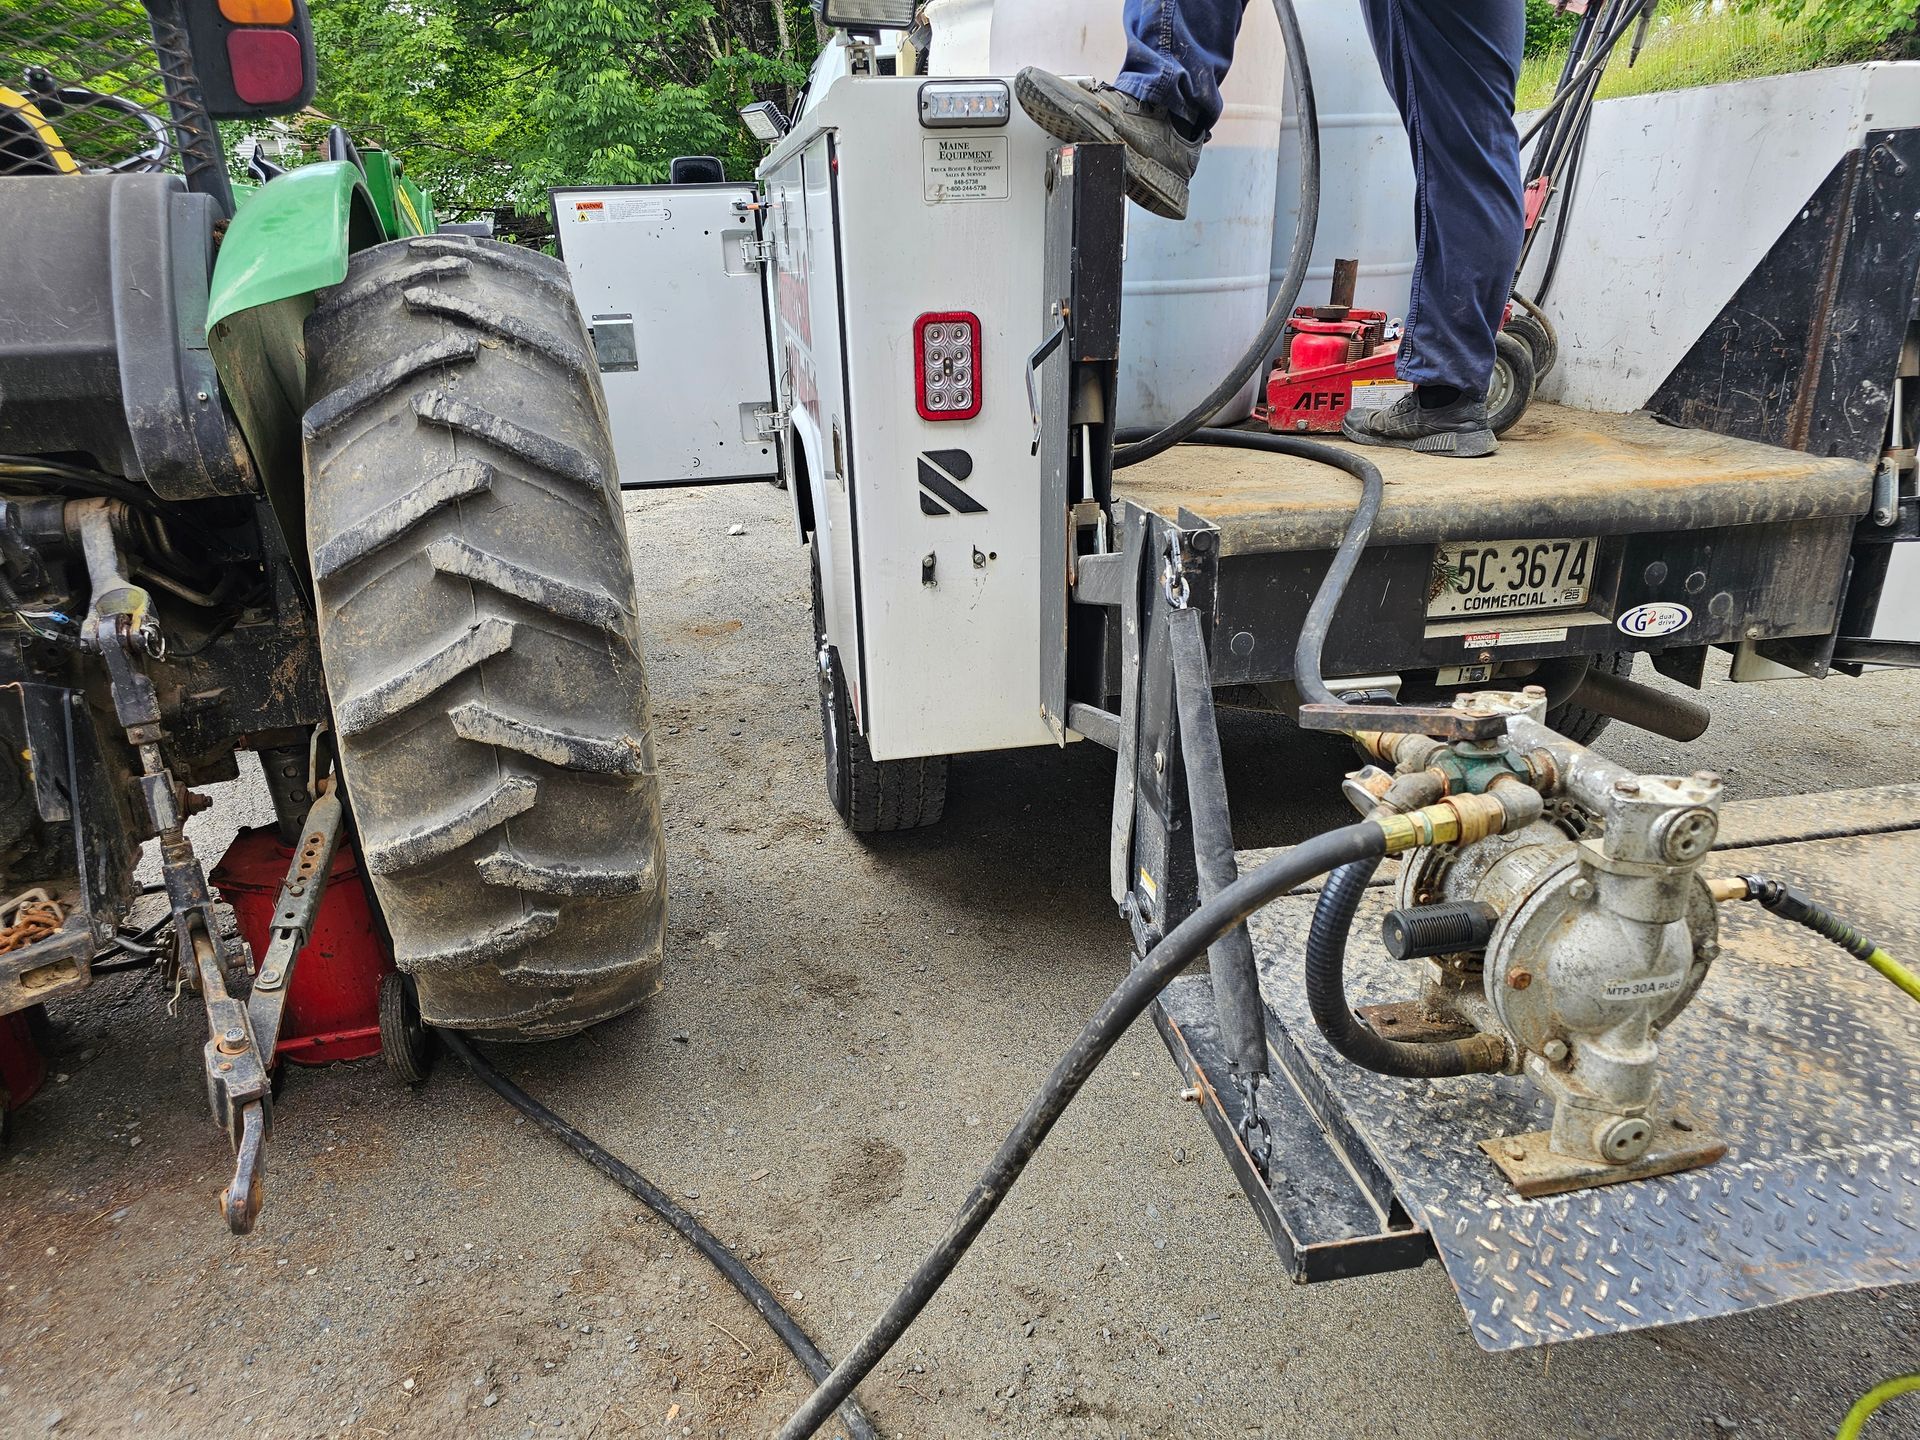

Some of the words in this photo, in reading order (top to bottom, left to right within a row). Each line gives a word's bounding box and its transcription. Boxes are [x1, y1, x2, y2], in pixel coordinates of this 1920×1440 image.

[939, 142, 970, 150] MAINE
[939, 150, 992, 161] EQUIPMENT
[1293, 392, 1345, 411] AFF
[1463, 591, 1547, 611] COMMERCIAL
[1564, 591, 1580, 600] 25
[1606, 986, 1630, 996] MTP
[1632, 981, 1656, 995] 30A
[1658, 978, 1680, 991] PLUS
